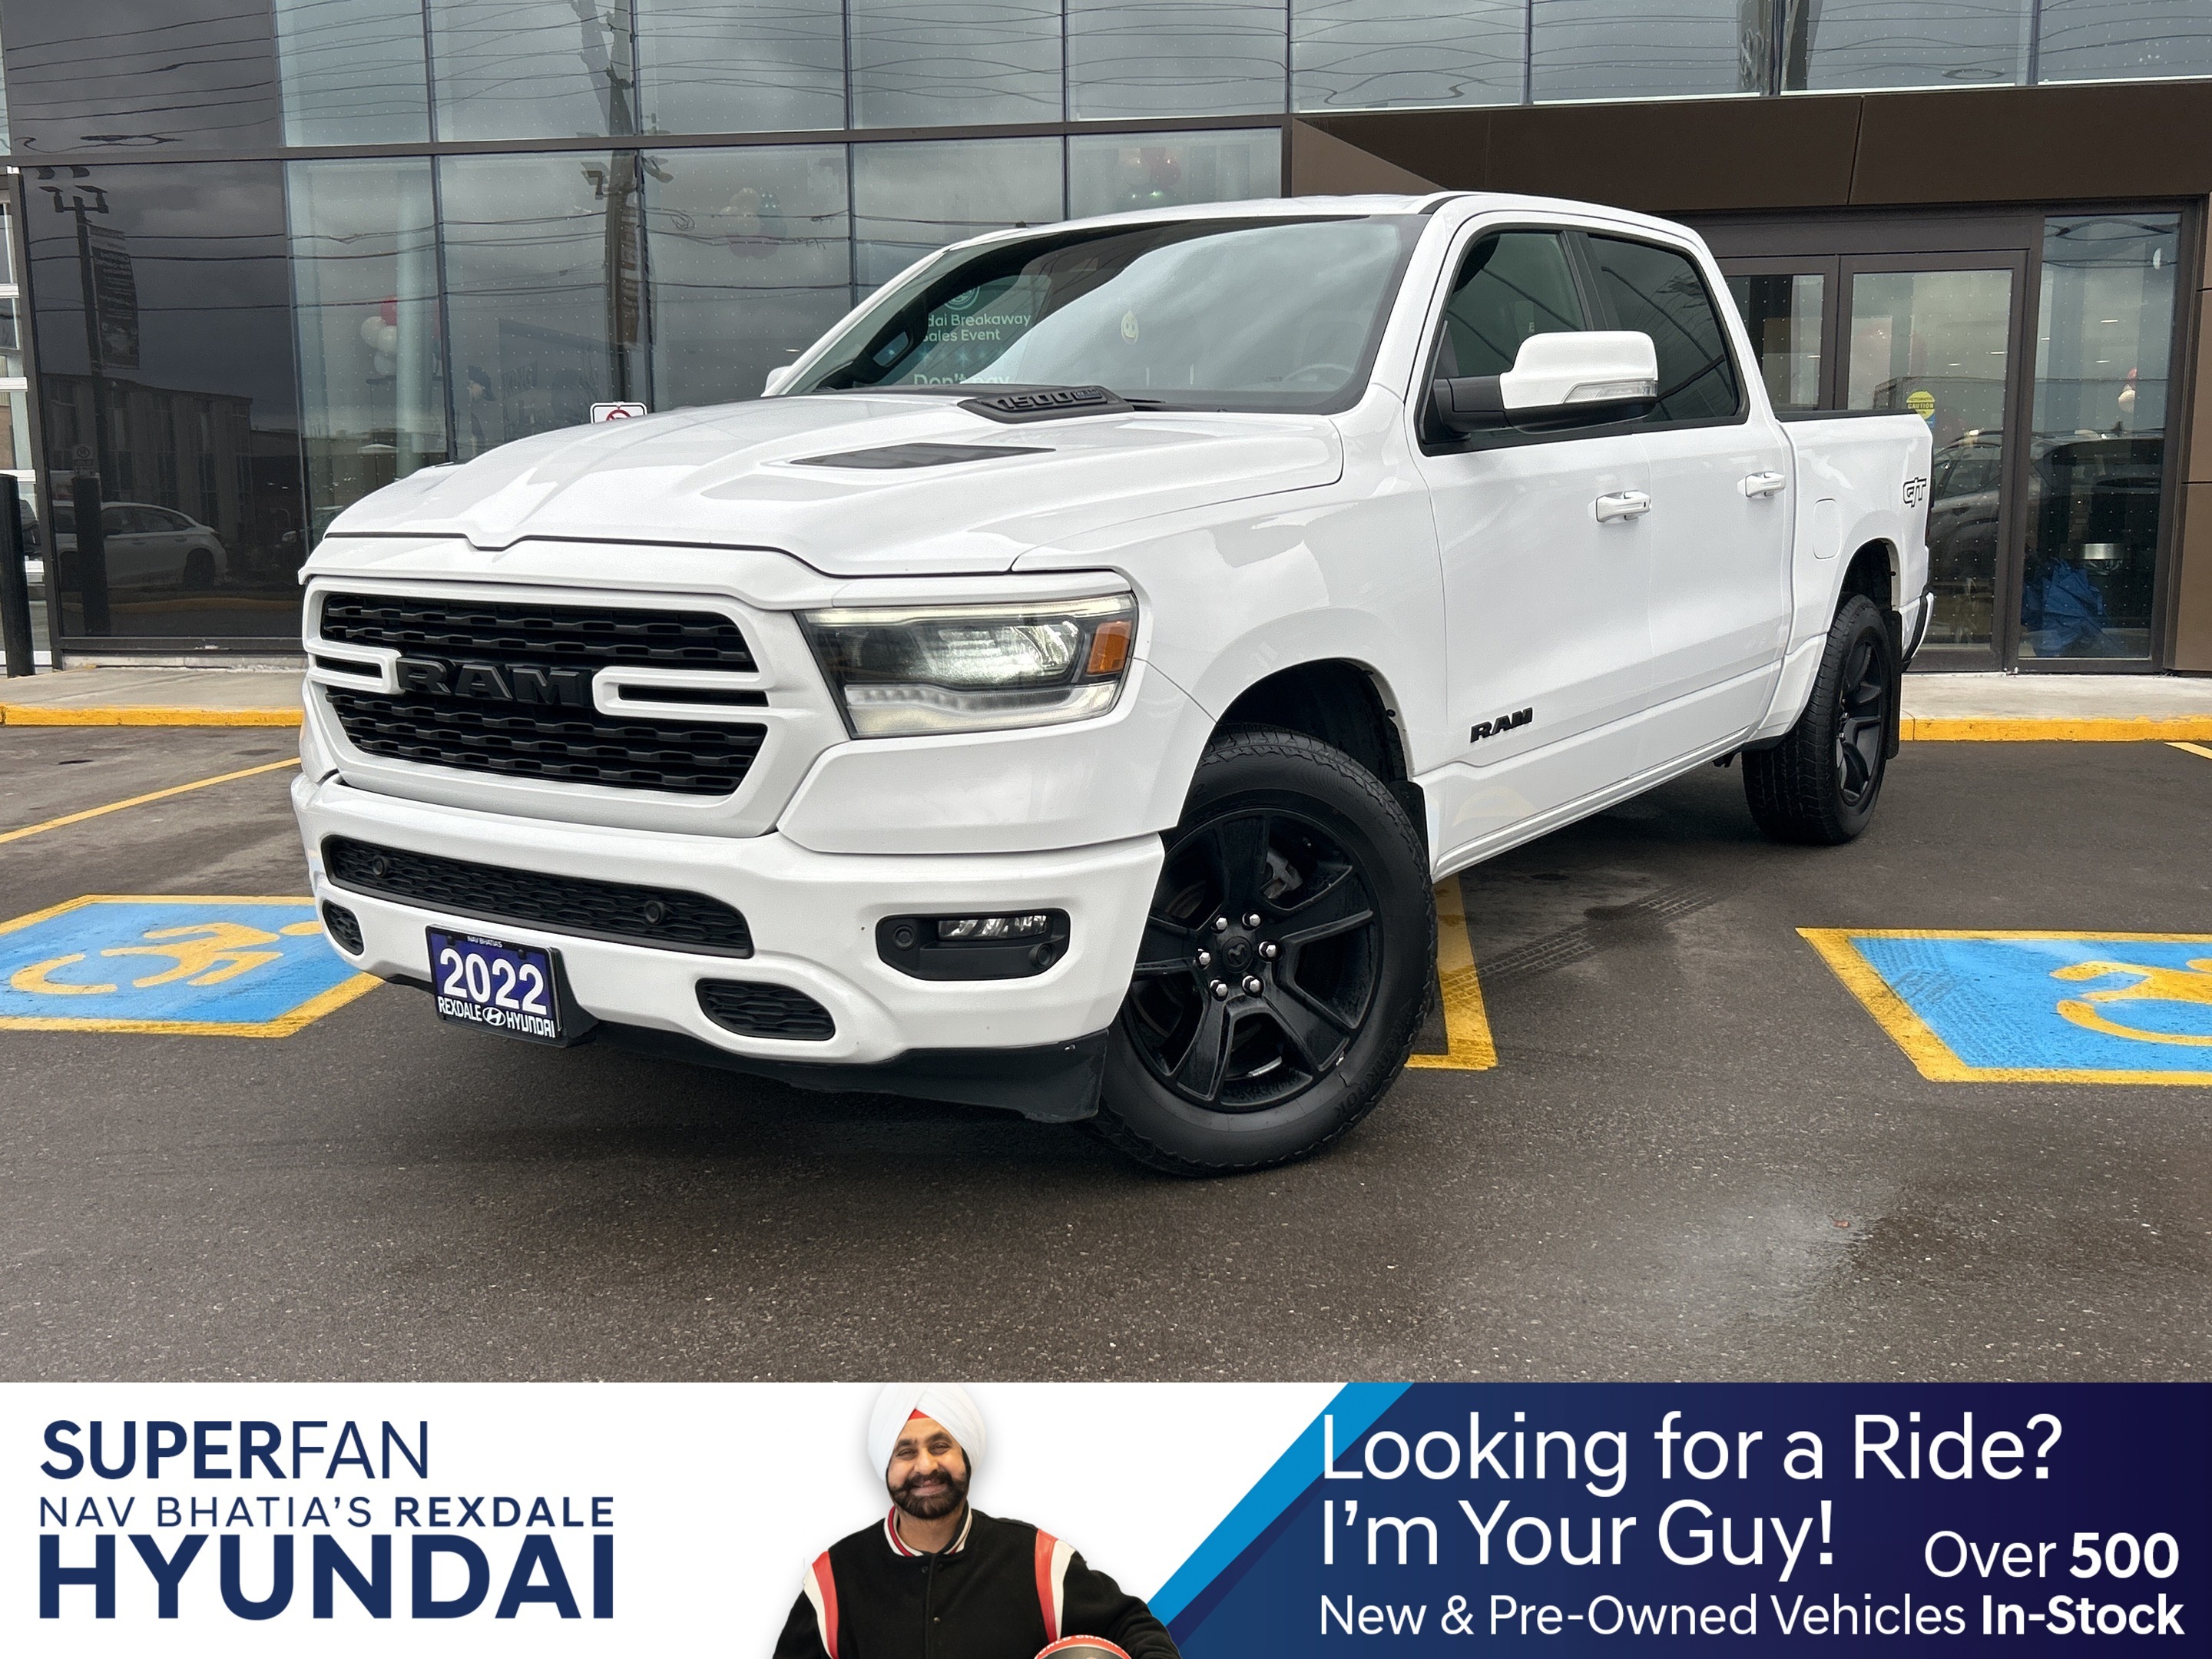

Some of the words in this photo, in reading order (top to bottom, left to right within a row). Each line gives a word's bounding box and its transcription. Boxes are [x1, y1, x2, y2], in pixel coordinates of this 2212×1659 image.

[951, 313, 1031, 327] Breakaway
[962, 329, 1000, 341] Event
[997, 392, 1074, 409] 1500
[396, 657, 585, 708] RAM
[1470, 707, 1533, 743] RAM
[440, 948, 547, 1015] 2022
[438, 995, 483, 1022] REXDALE
[505, 1010, 556, 1038] HYUNDAI
